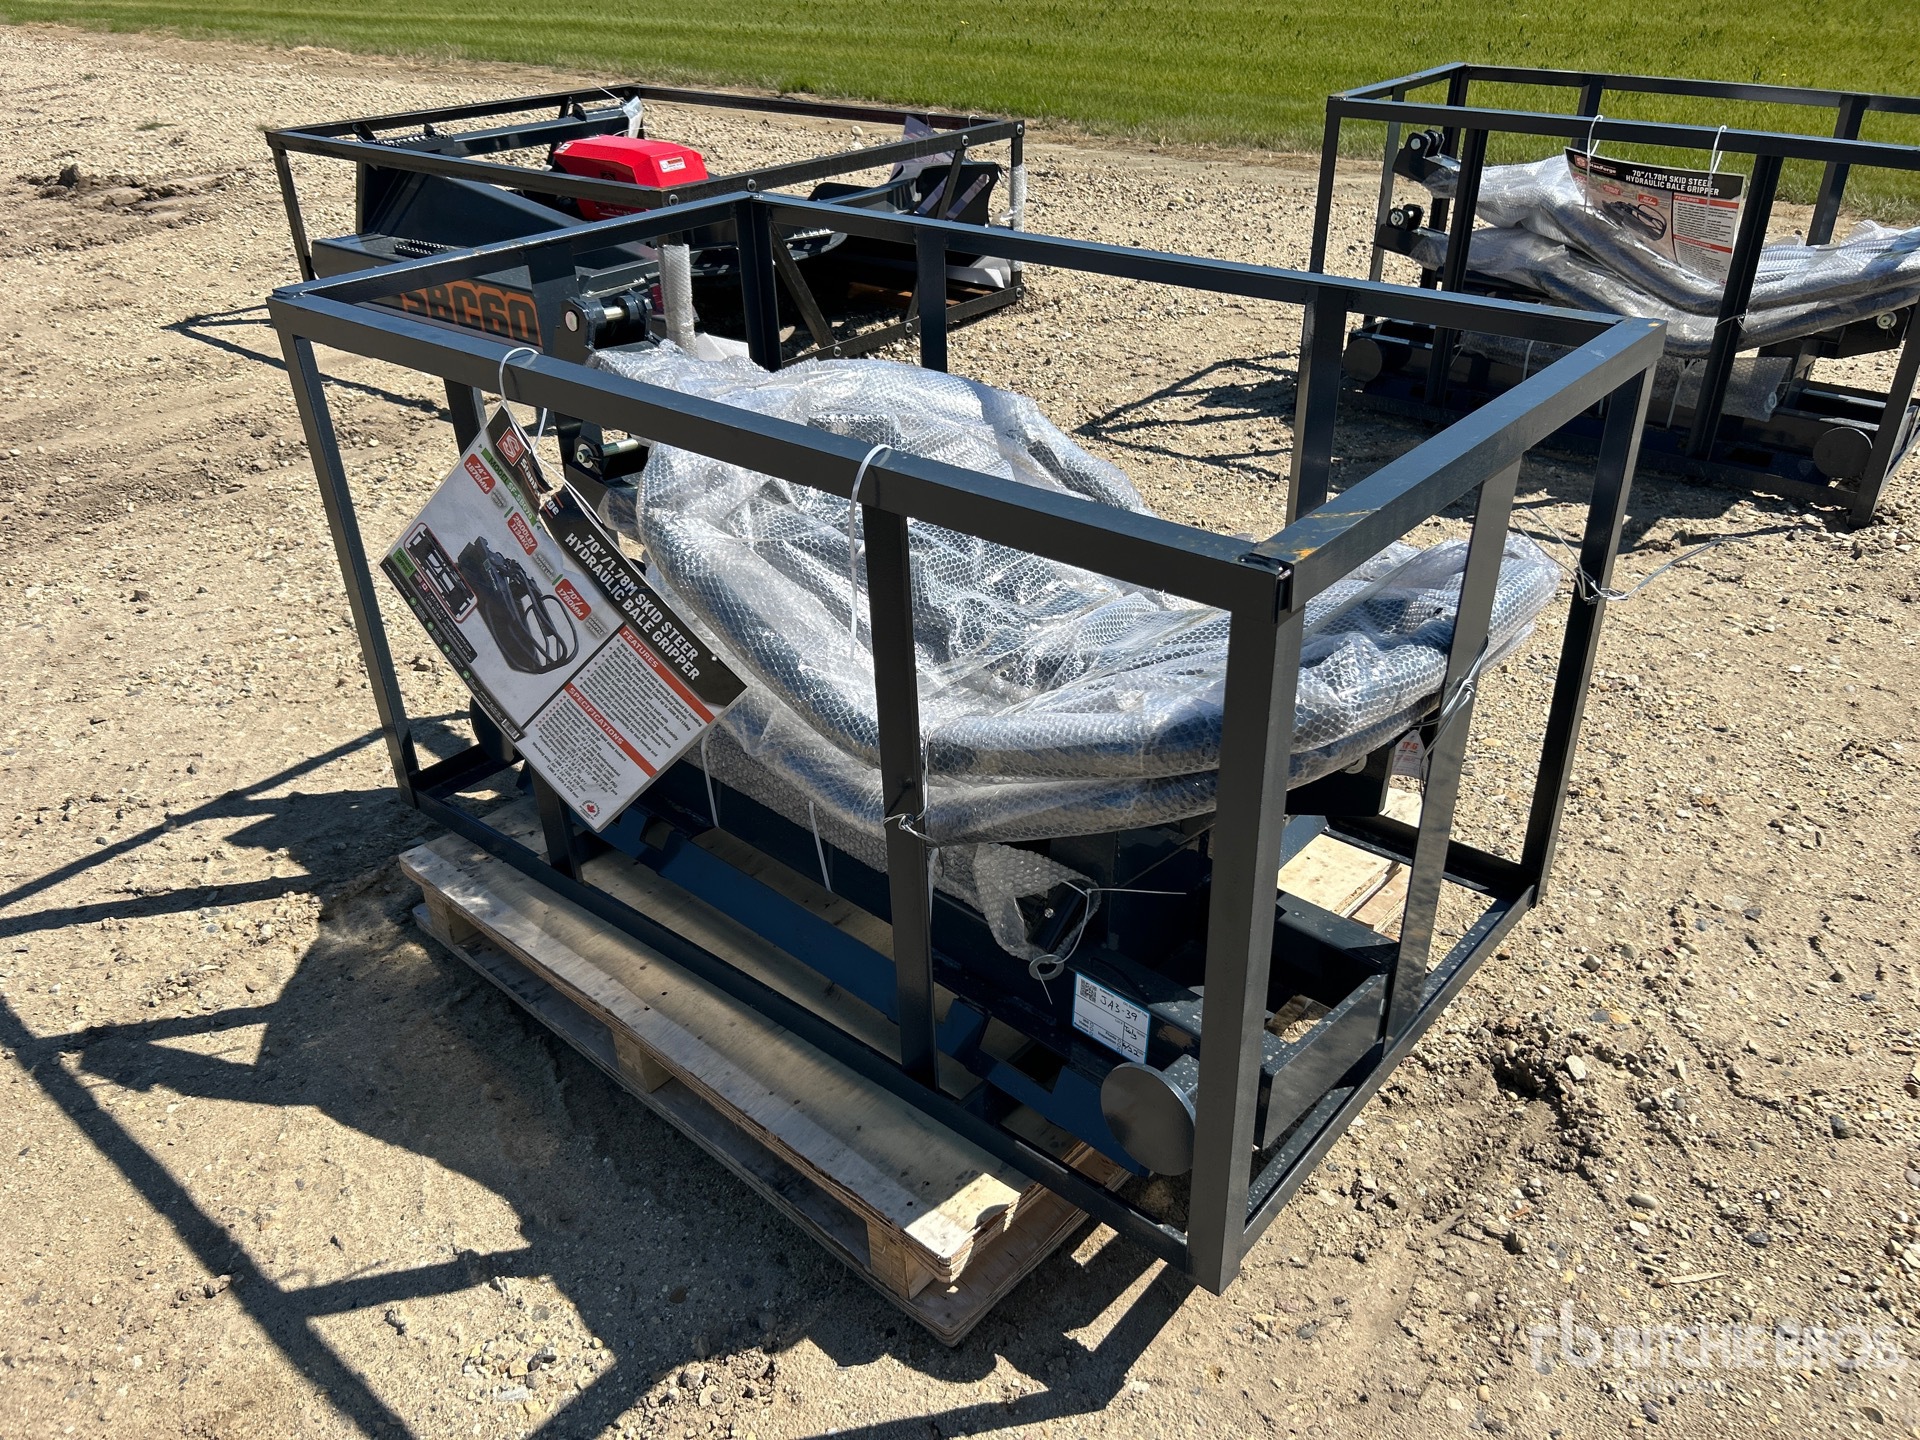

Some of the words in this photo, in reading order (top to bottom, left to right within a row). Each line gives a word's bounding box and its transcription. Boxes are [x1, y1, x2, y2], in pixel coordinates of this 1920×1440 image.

[1625, 175, 1665, 188] HYDRAULIC
[1666, 182, 1685, 191] BALE
[1687, 185, 1720, 196] GRIPPER
[1632, 169, 1668, 182] 70"/1.78M
[1669, 176, 1687, 184] SKID
[473, 461, 489, 482] 74"/
[488, 456, 509, 484] MODEL
[512, 514, 536, 549] 2500LB/
[557, 587, 583, 618] 1780MM
[564, 532, 625, 602] HYDRAULIC
[622, 598, 653, 634] BALE
[651, 629, 701, 681] GRIPPER
[565, 587, 583, 608] 70"/
[584, 534, 638, 596] 70"/1.78M
[634, 593, 664, 624] SKID
[660, 621, 699, 662] STEER
[622, 629, 659, 668] FEATURES
[567, 686, 624, 745] SPECIFICATIONS
[1099, 995, 1138, 1021] JA3-39
